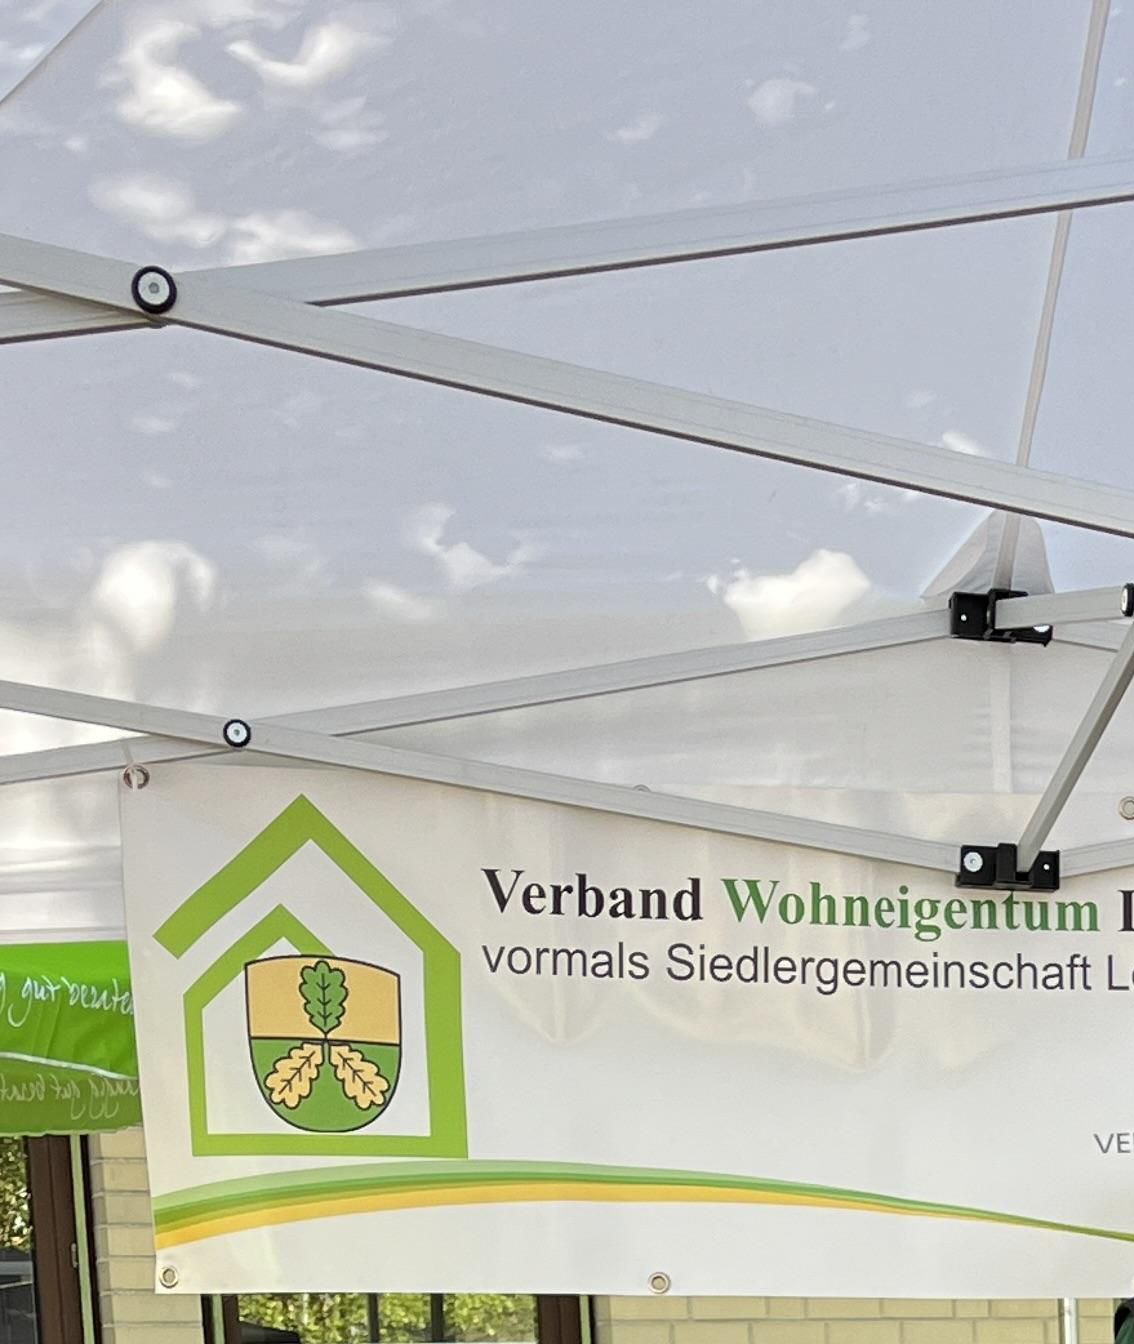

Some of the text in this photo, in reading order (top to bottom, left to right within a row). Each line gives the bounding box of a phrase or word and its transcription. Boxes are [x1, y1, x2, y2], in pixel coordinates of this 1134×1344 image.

[480, 868, 703, 921] Verband
[721, 878, 1101, 942] Wohneigentum
[482, 941, 650, 980] vormals
[666, 943, 1092, 995] Siedlergemeinschaft
[61, 977, 135, 1015] berate
